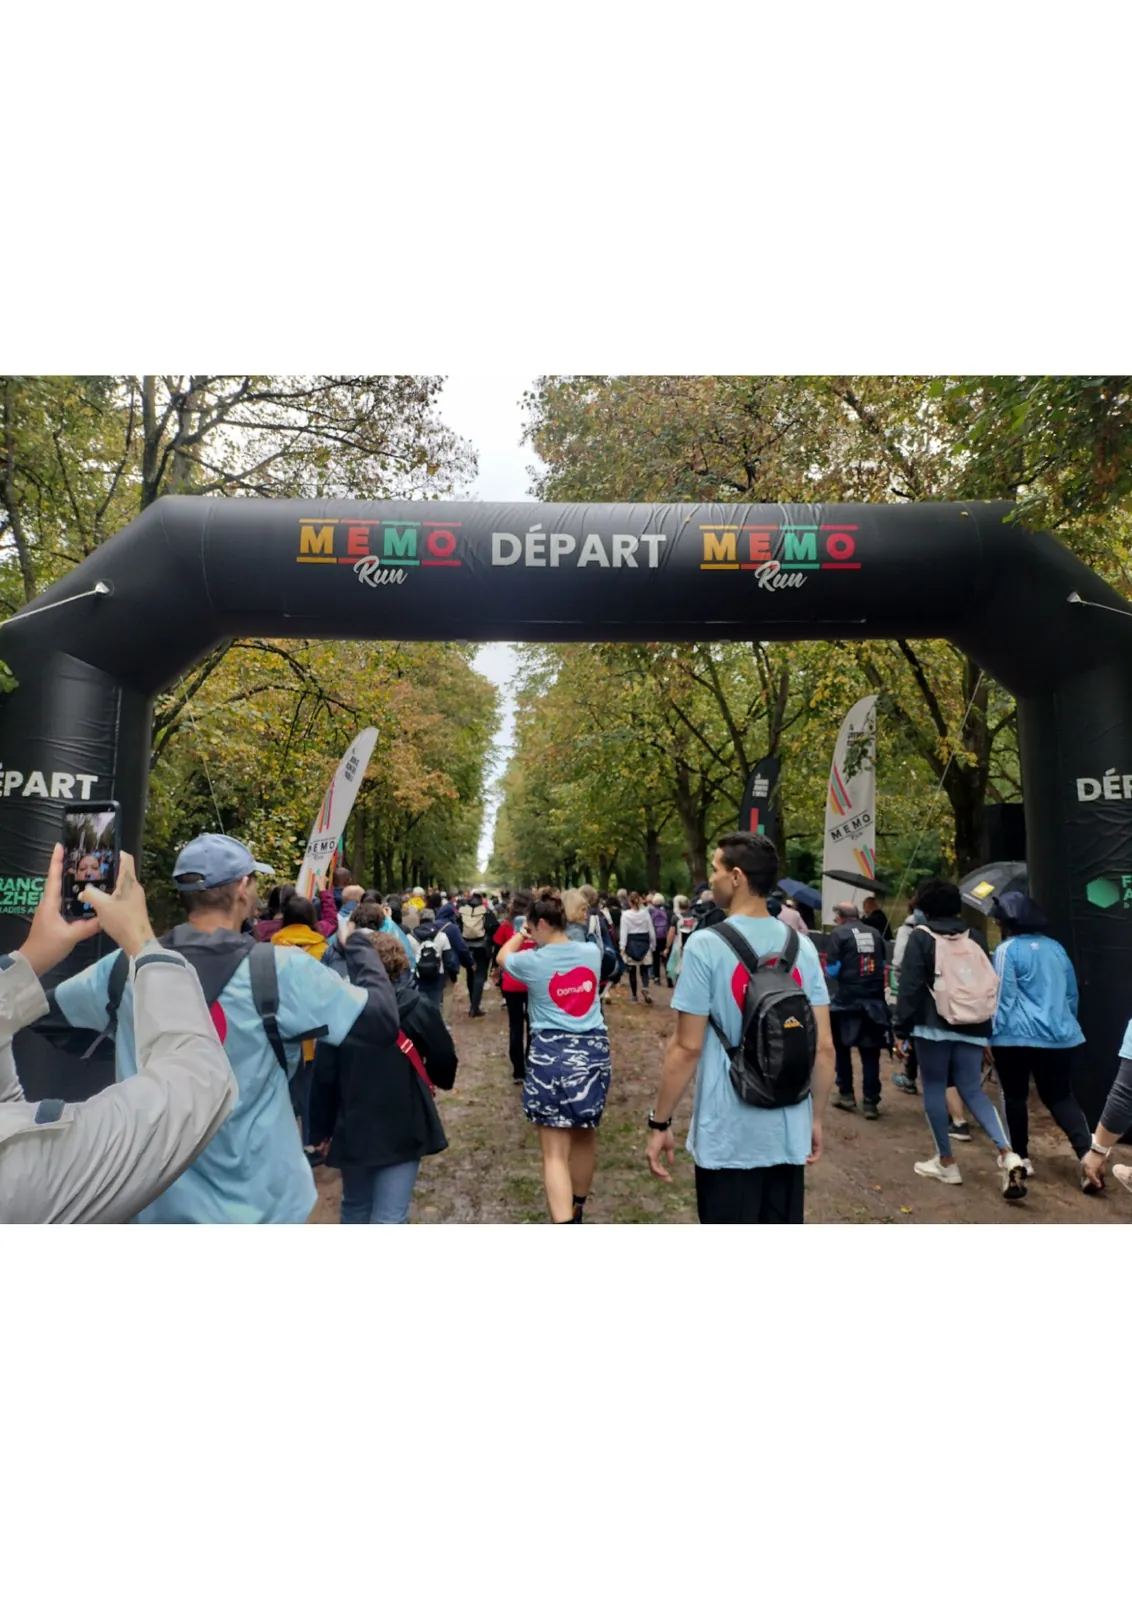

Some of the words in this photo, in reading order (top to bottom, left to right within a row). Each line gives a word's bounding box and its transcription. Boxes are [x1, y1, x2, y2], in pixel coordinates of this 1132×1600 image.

[299, 525, 458, 558] MEMO
[491, 523, 667, 568] DÉPART
[703, 532, 856, 561] MEMO
[353, 555, 409, 588] Run
[754, 560, 808, 592] Run
[0, 762, 99, 800] PART
[830, 813, 871, 841] MEMO
